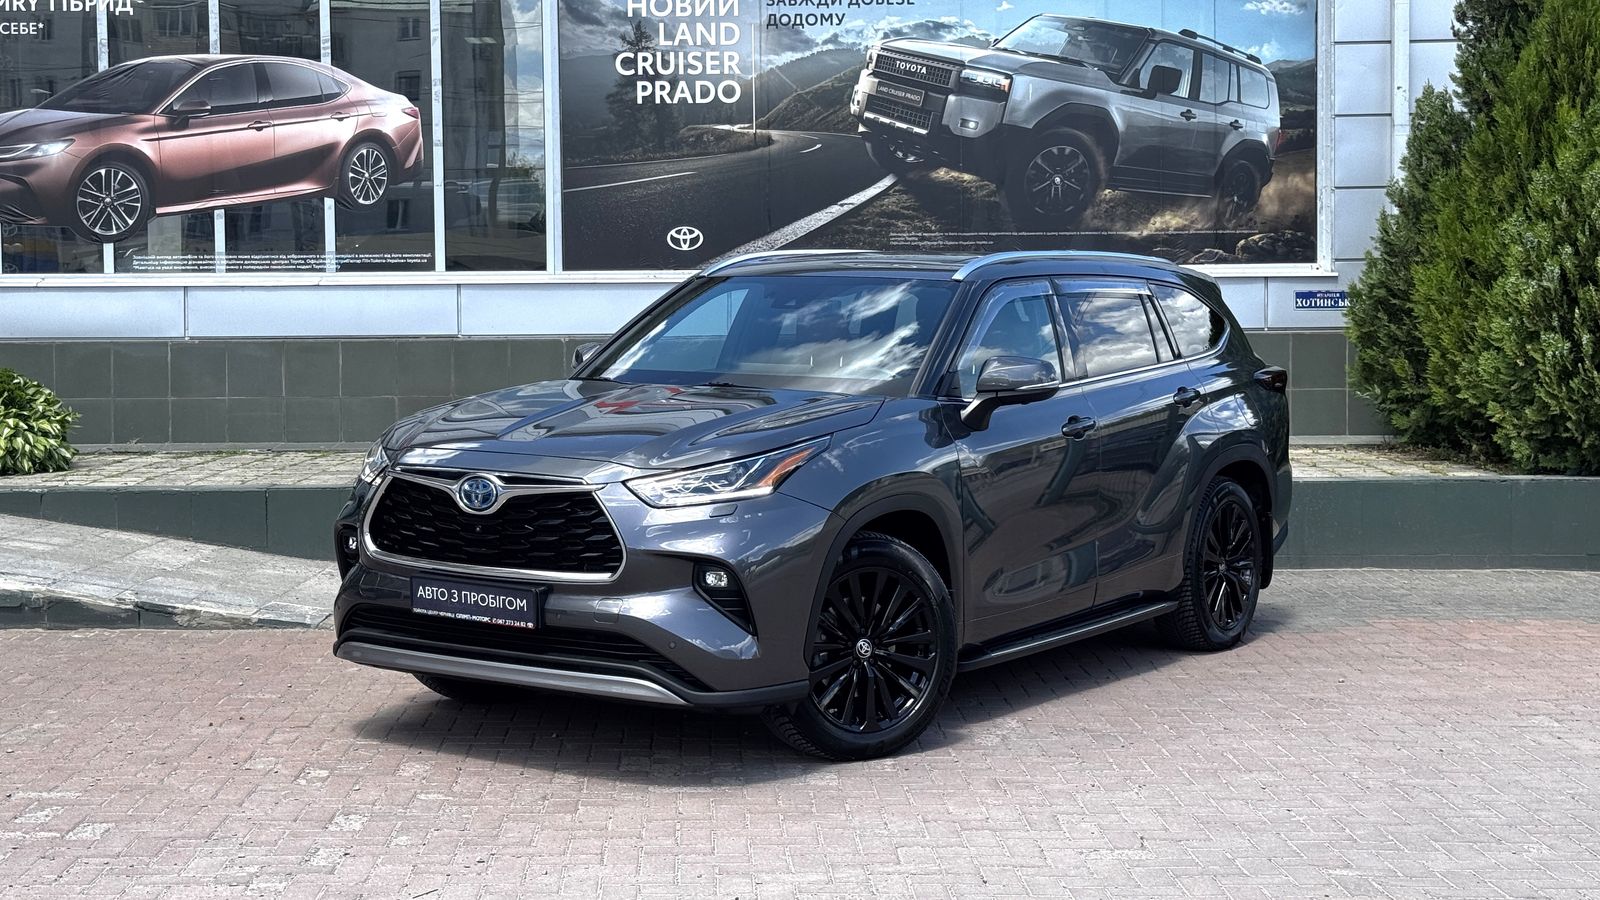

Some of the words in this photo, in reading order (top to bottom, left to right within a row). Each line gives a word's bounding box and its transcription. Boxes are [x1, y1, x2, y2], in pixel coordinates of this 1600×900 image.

[766, 13, 846, 29] ДОДОМУ
[658, 22, 741, 46] LAND
[615, 51, 742, 76] CRUISER
[896, 61, 927, 75] TOYOTA
[636, 80, 742, 105] PRADO
[877, 85, 889, 93] LAND
[888, 88, 906, 98] CRUISER
[905, 92, 921, 102] PRADO
[1296, 298, 1351, 307] ХОТИНСЬК
[417, 585, 448, 601] АВТО
[461, 590, 528, 612] ПРОБІГОМ
